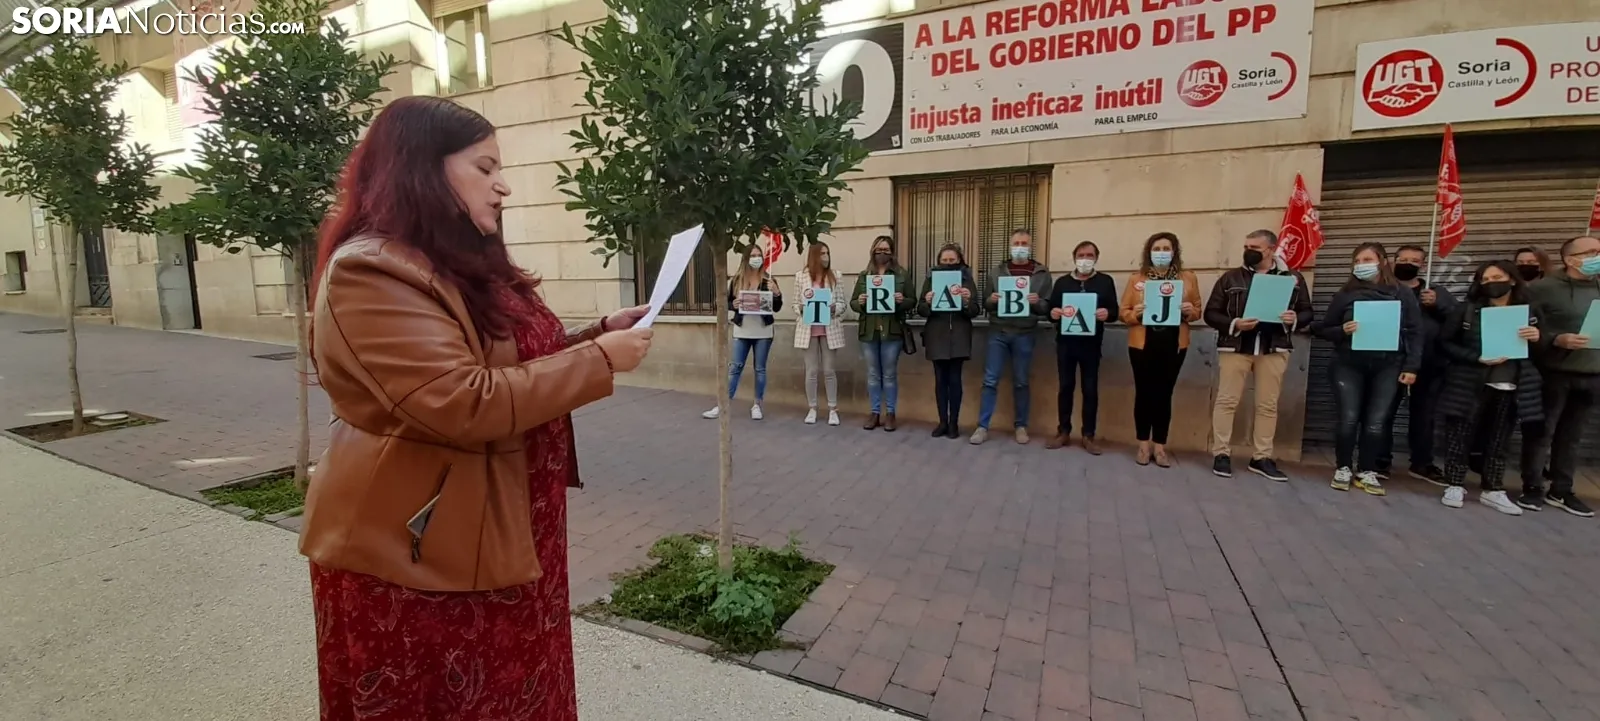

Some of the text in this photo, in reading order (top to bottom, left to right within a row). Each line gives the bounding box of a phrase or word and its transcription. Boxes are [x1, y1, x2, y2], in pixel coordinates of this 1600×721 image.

[914, 23, 934, 49] A
[942, 16, 976, 44] LA
[985, 0, 1130, 37] REFORMA
[931, 4, 1277, 77] DEL GOBIERNO DEL PP
[1182, 66, 1223, 87] UGT
[1238, 67, 1276, 80] Soria
[1372, 58, 1434, 90] UGT
[1457, 59, 1511, 75] Soria
[1550, 61, 1600, 79] PRO
[1231, 80, 1257, 89] Castilla
[1447, 76, 1520, 89] Castilla y León
[910, 78, 1163, 134] injusta ineficaz inútil
[991, 128, 1009, 136] PARA
[1021, 121, 1059, 133] ECONOMÍA
[1094, 117, 1115, 125] PARA
[1127, 112, 1158, 122] EMPLEO
[936, 131, 981, 142] TRABAJADORES
[869, 288, 892, 311] R
[935, 284, 959, 309] A
[1002, 290, 1024, 315] B
[807, 301, 828, 323] T
[1151, 295, 1175, 323] J
[1066, 308, 1092, 333] A
